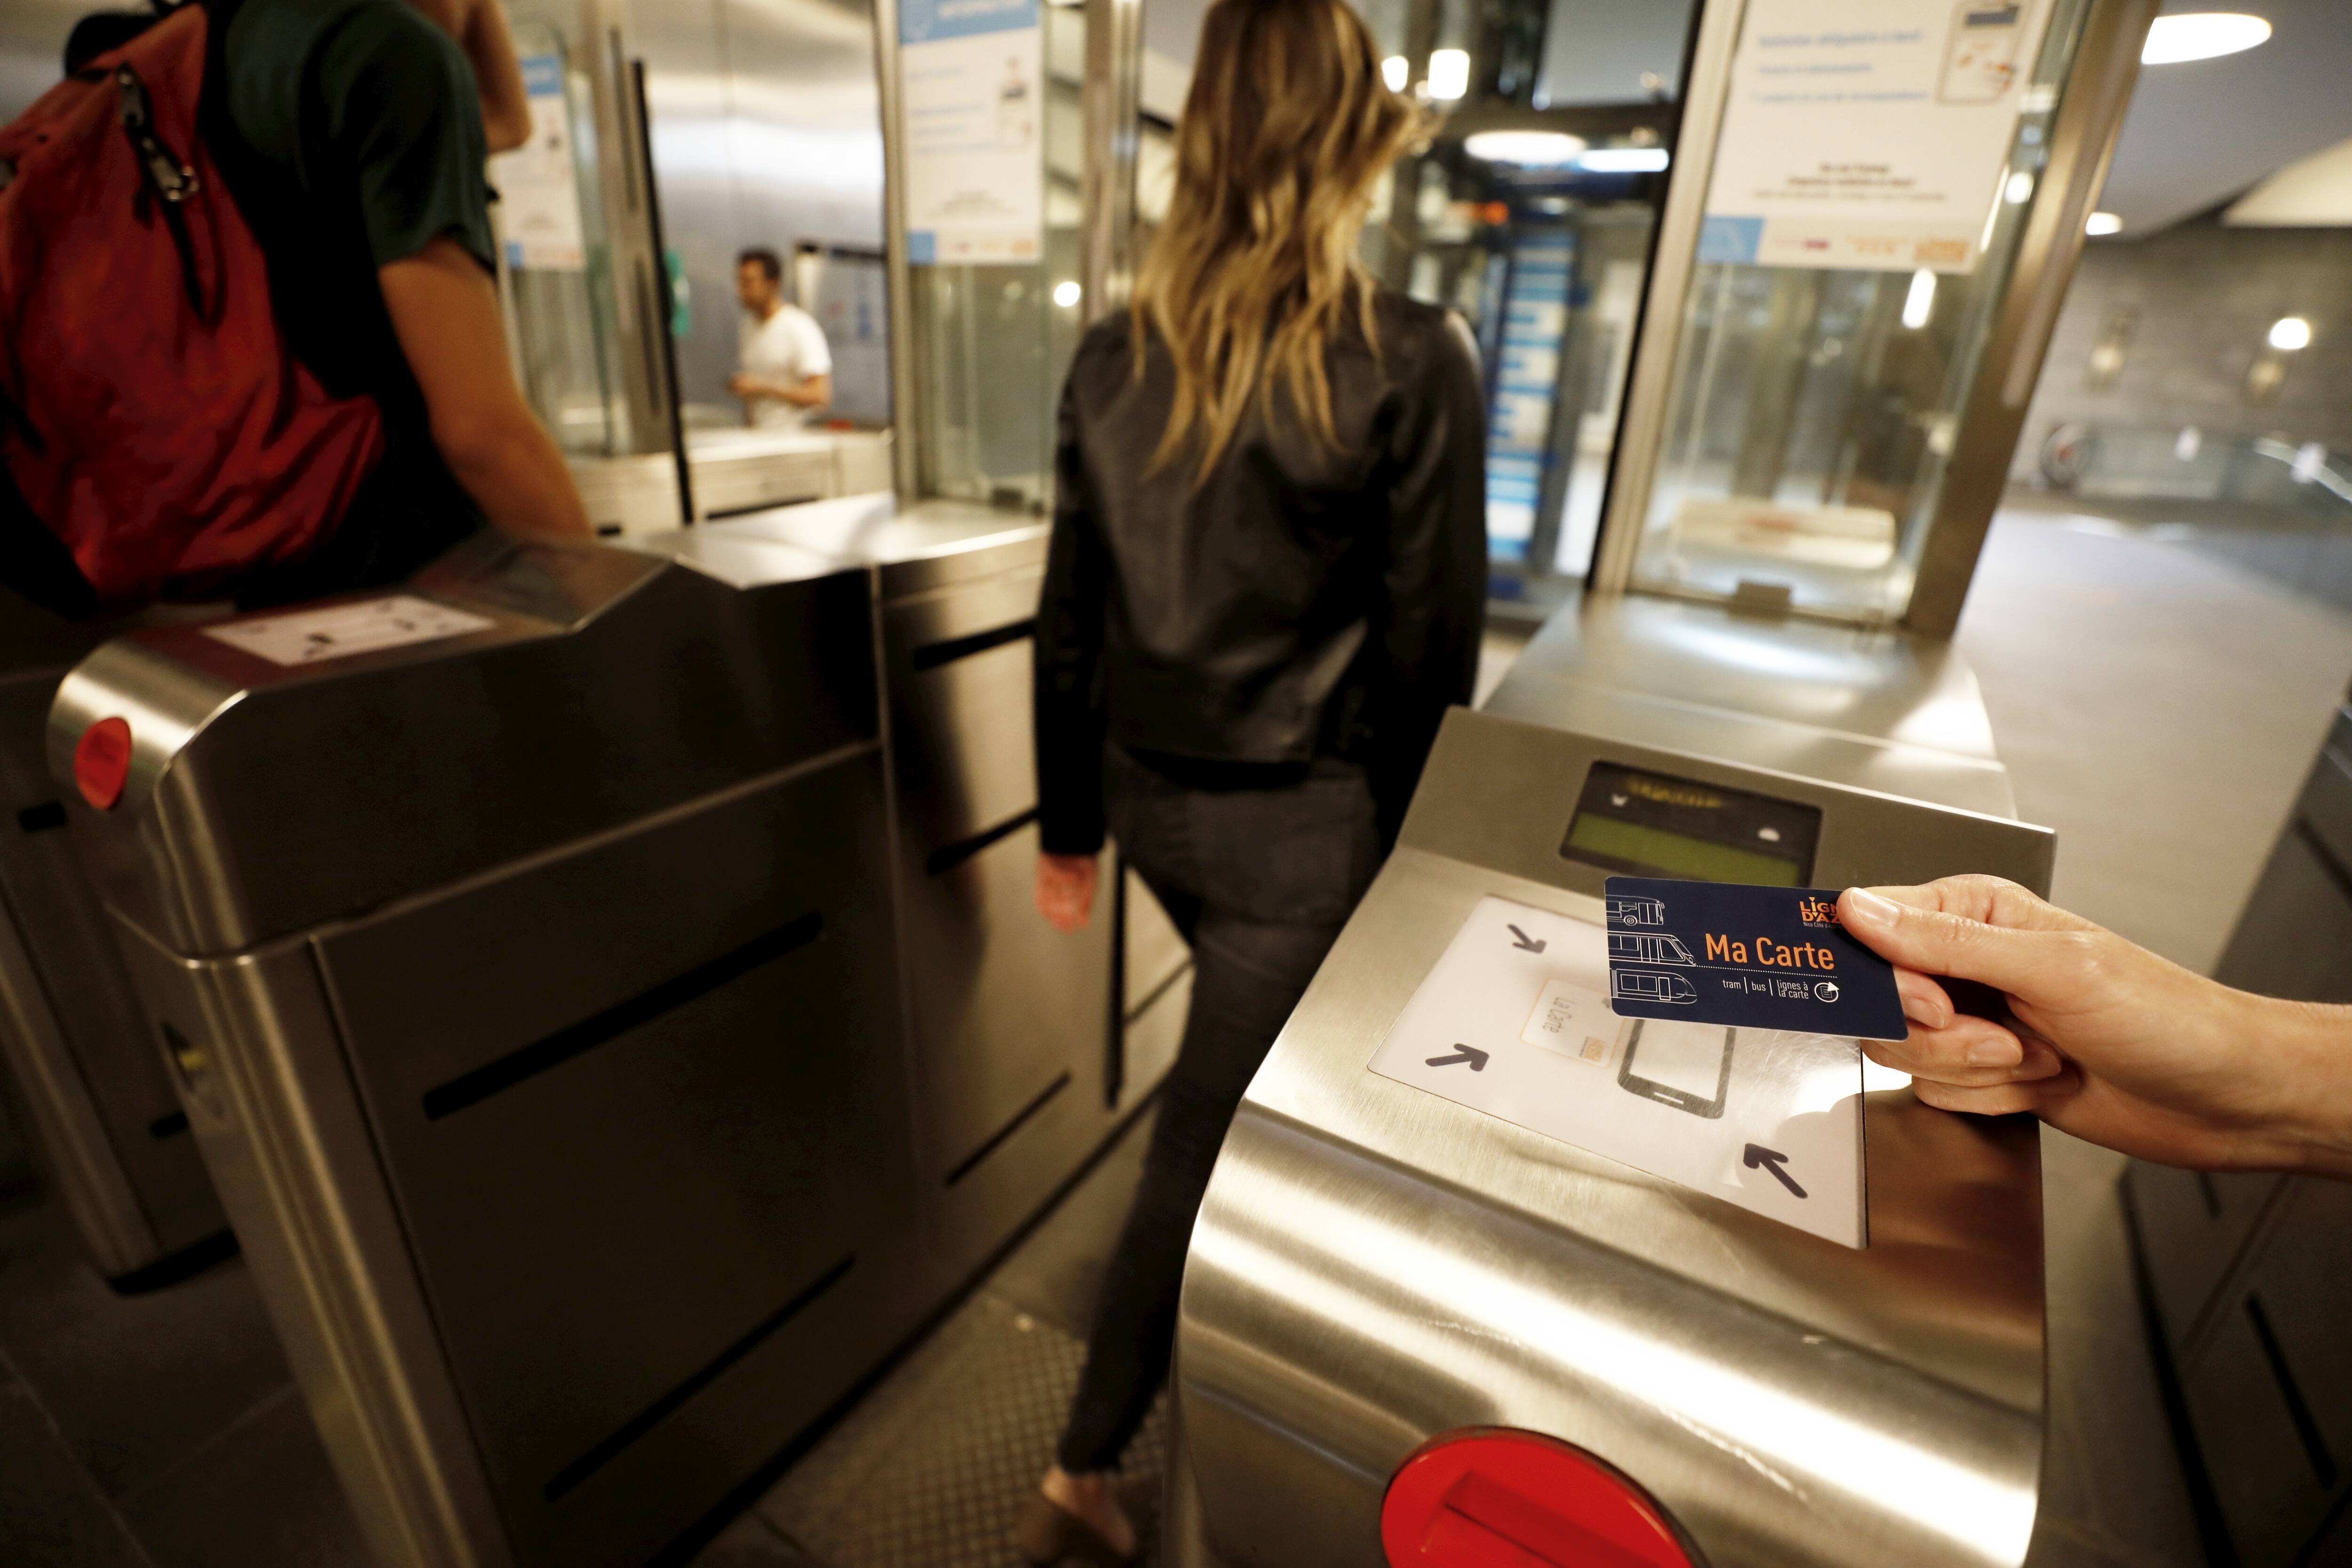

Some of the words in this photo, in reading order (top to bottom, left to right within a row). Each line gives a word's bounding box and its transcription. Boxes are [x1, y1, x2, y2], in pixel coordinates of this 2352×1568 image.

[1799, 897, 1837, 913] LIGN
[1705, 933, 1748, 963] Ma
[1756, 937, 1835, 970] Carte
[1723, 979, 1741, 989] tram
[1751, 981, 1766, 991] bus
[1776, 979, 1801, 992] lignes
[1803, 981, 1809, 990] à
[1778, 988, 1786, 997] la
[1788, 990, 1809, 999] carte
[1553, 997, 1578, 1009] La
[1542, 1009, 1572, 1033] Carte
